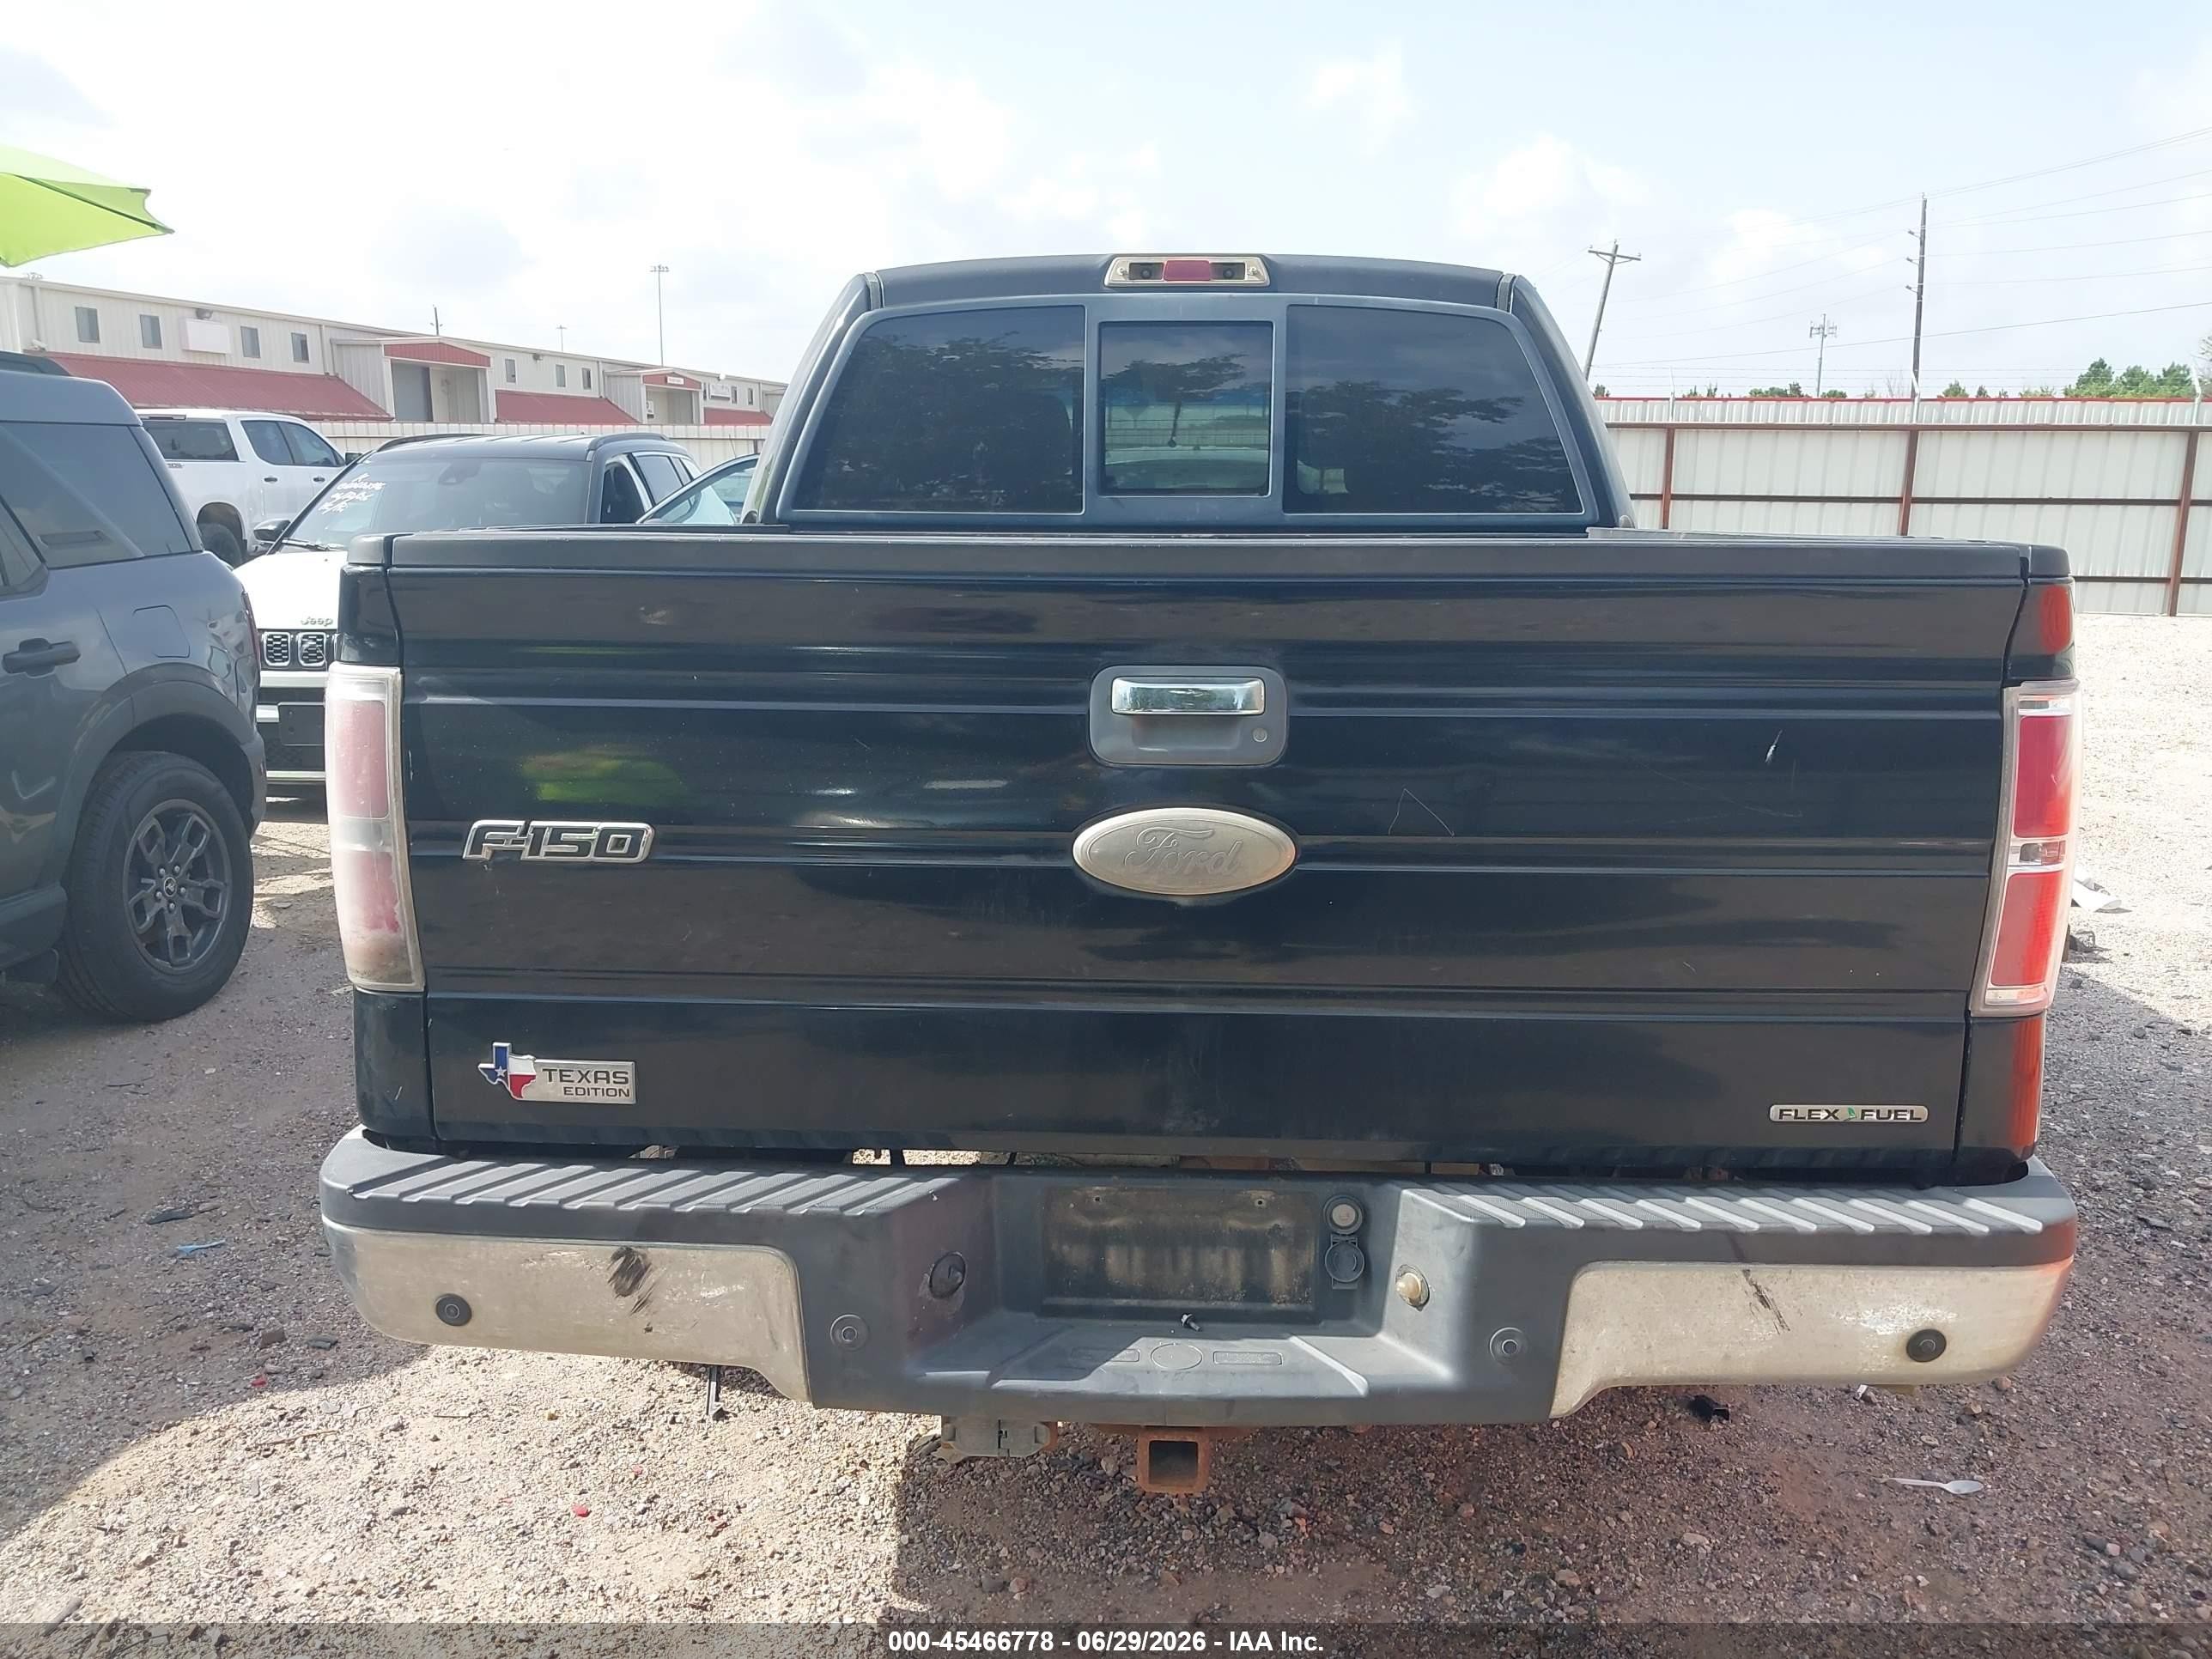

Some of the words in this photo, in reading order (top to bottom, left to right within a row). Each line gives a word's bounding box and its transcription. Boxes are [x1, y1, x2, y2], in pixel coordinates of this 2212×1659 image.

[301, 616, 333, 628] Jeep
[462, 819, 655, 863] F-150
[1123, 825, 1243, 876] Ford
[542, 1067, 629, 1085] TEXAS
[563, 1085, 630, 1097] EDITION
[1778, 1108, 1840, 1121] FLEX
[1860, 1109, 1923, 1121] FUEL
